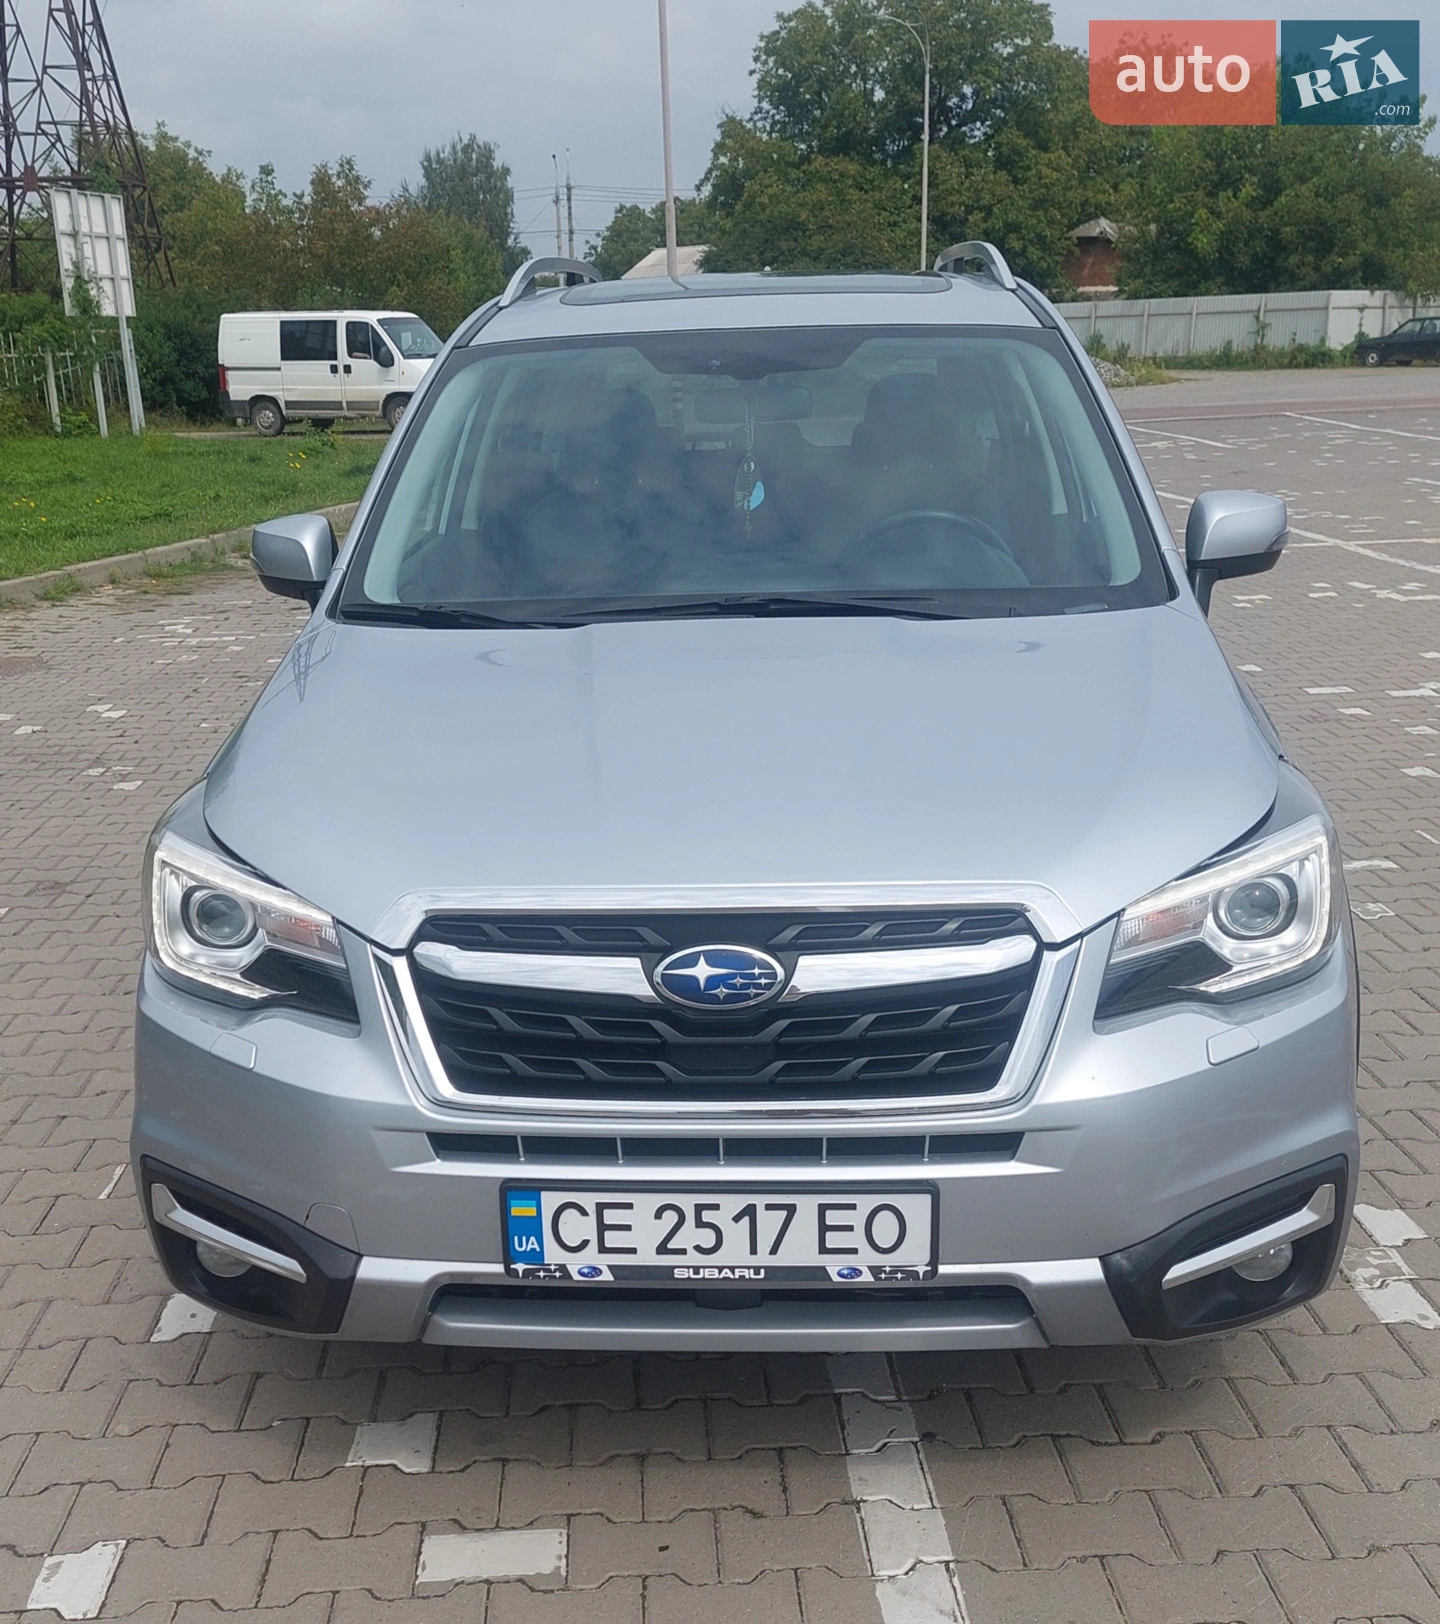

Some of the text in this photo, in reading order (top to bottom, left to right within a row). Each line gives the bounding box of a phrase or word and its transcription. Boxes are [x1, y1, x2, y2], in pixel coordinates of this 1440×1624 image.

[551, 1201, 907, 1256] CE 2517 EO
[513, 1236, 541, 1253] UA
[673, 1267, 765, 1280] SUBARU
